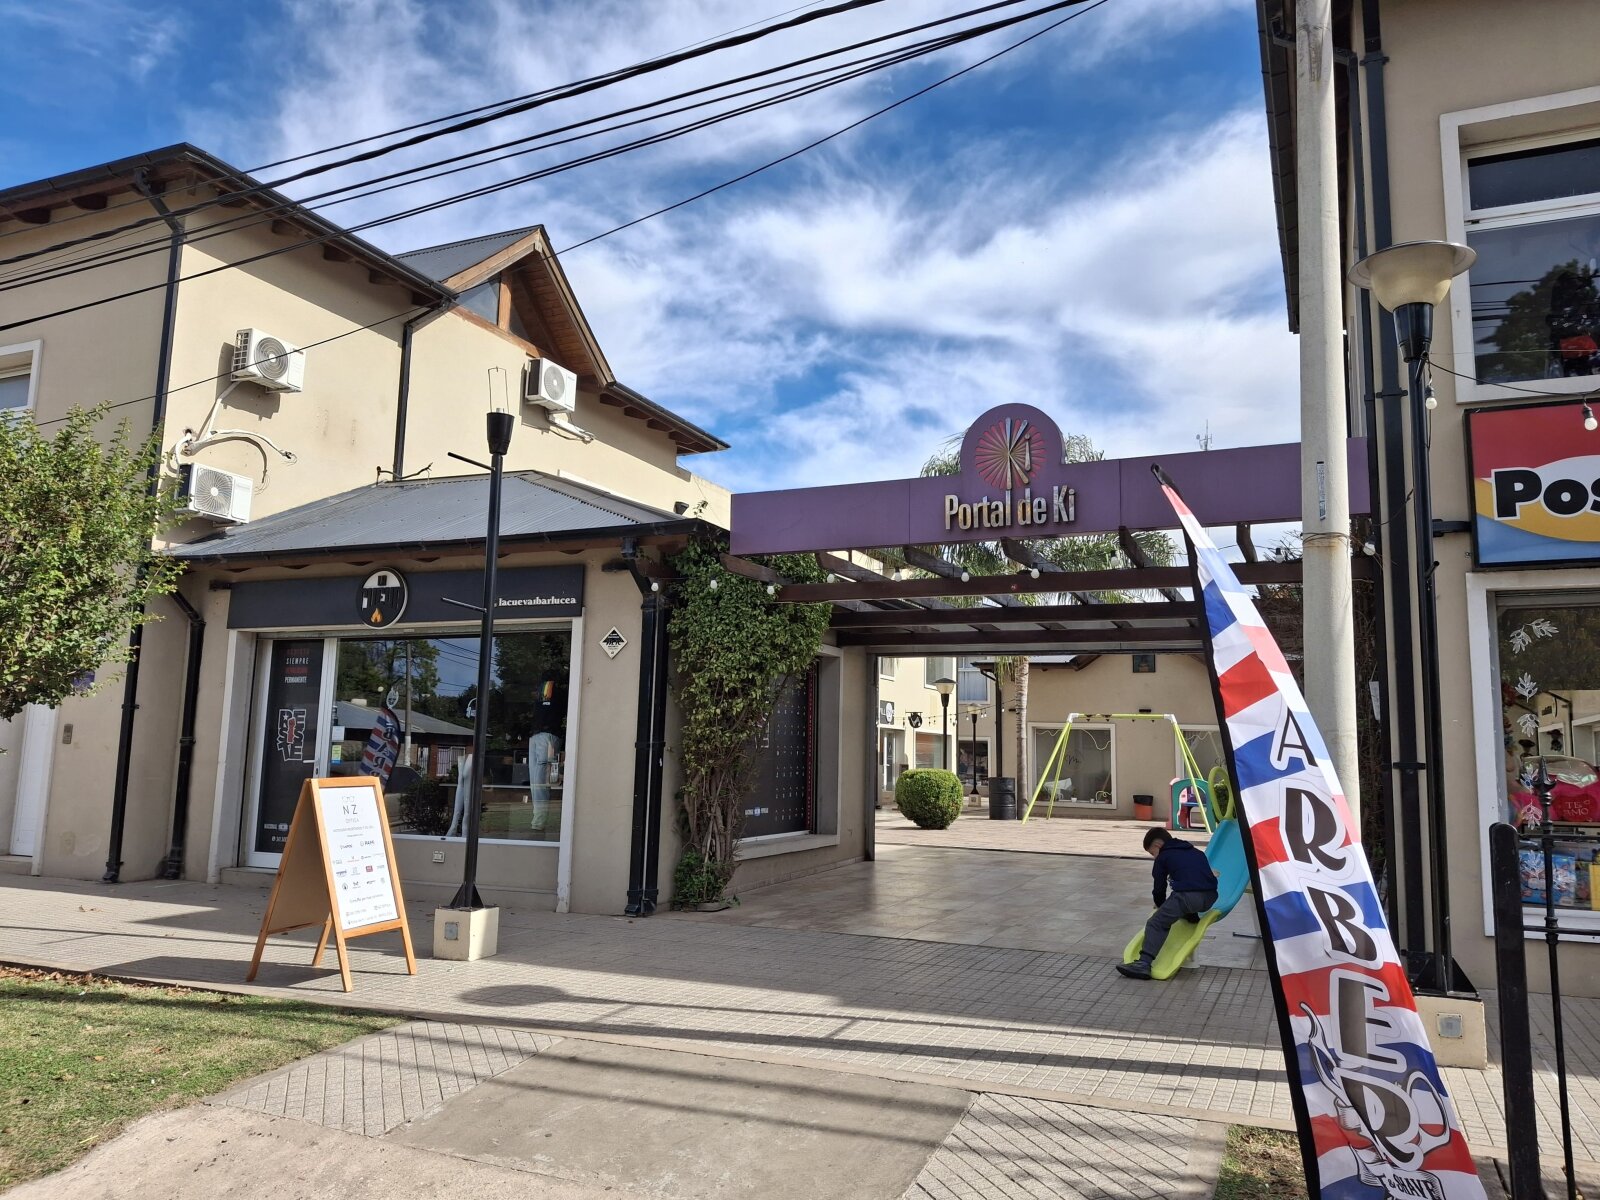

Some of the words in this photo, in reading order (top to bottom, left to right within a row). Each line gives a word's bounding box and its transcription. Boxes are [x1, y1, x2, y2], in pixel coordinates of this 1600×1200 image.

[944, 490, 1012, 530] Portal
[1017, 488, 1048, 526] de
[1053, 485, 1076, 523] Ki
[1494, 469, 1600, 518] Po
[1565, 801, 1583, 809] TE
